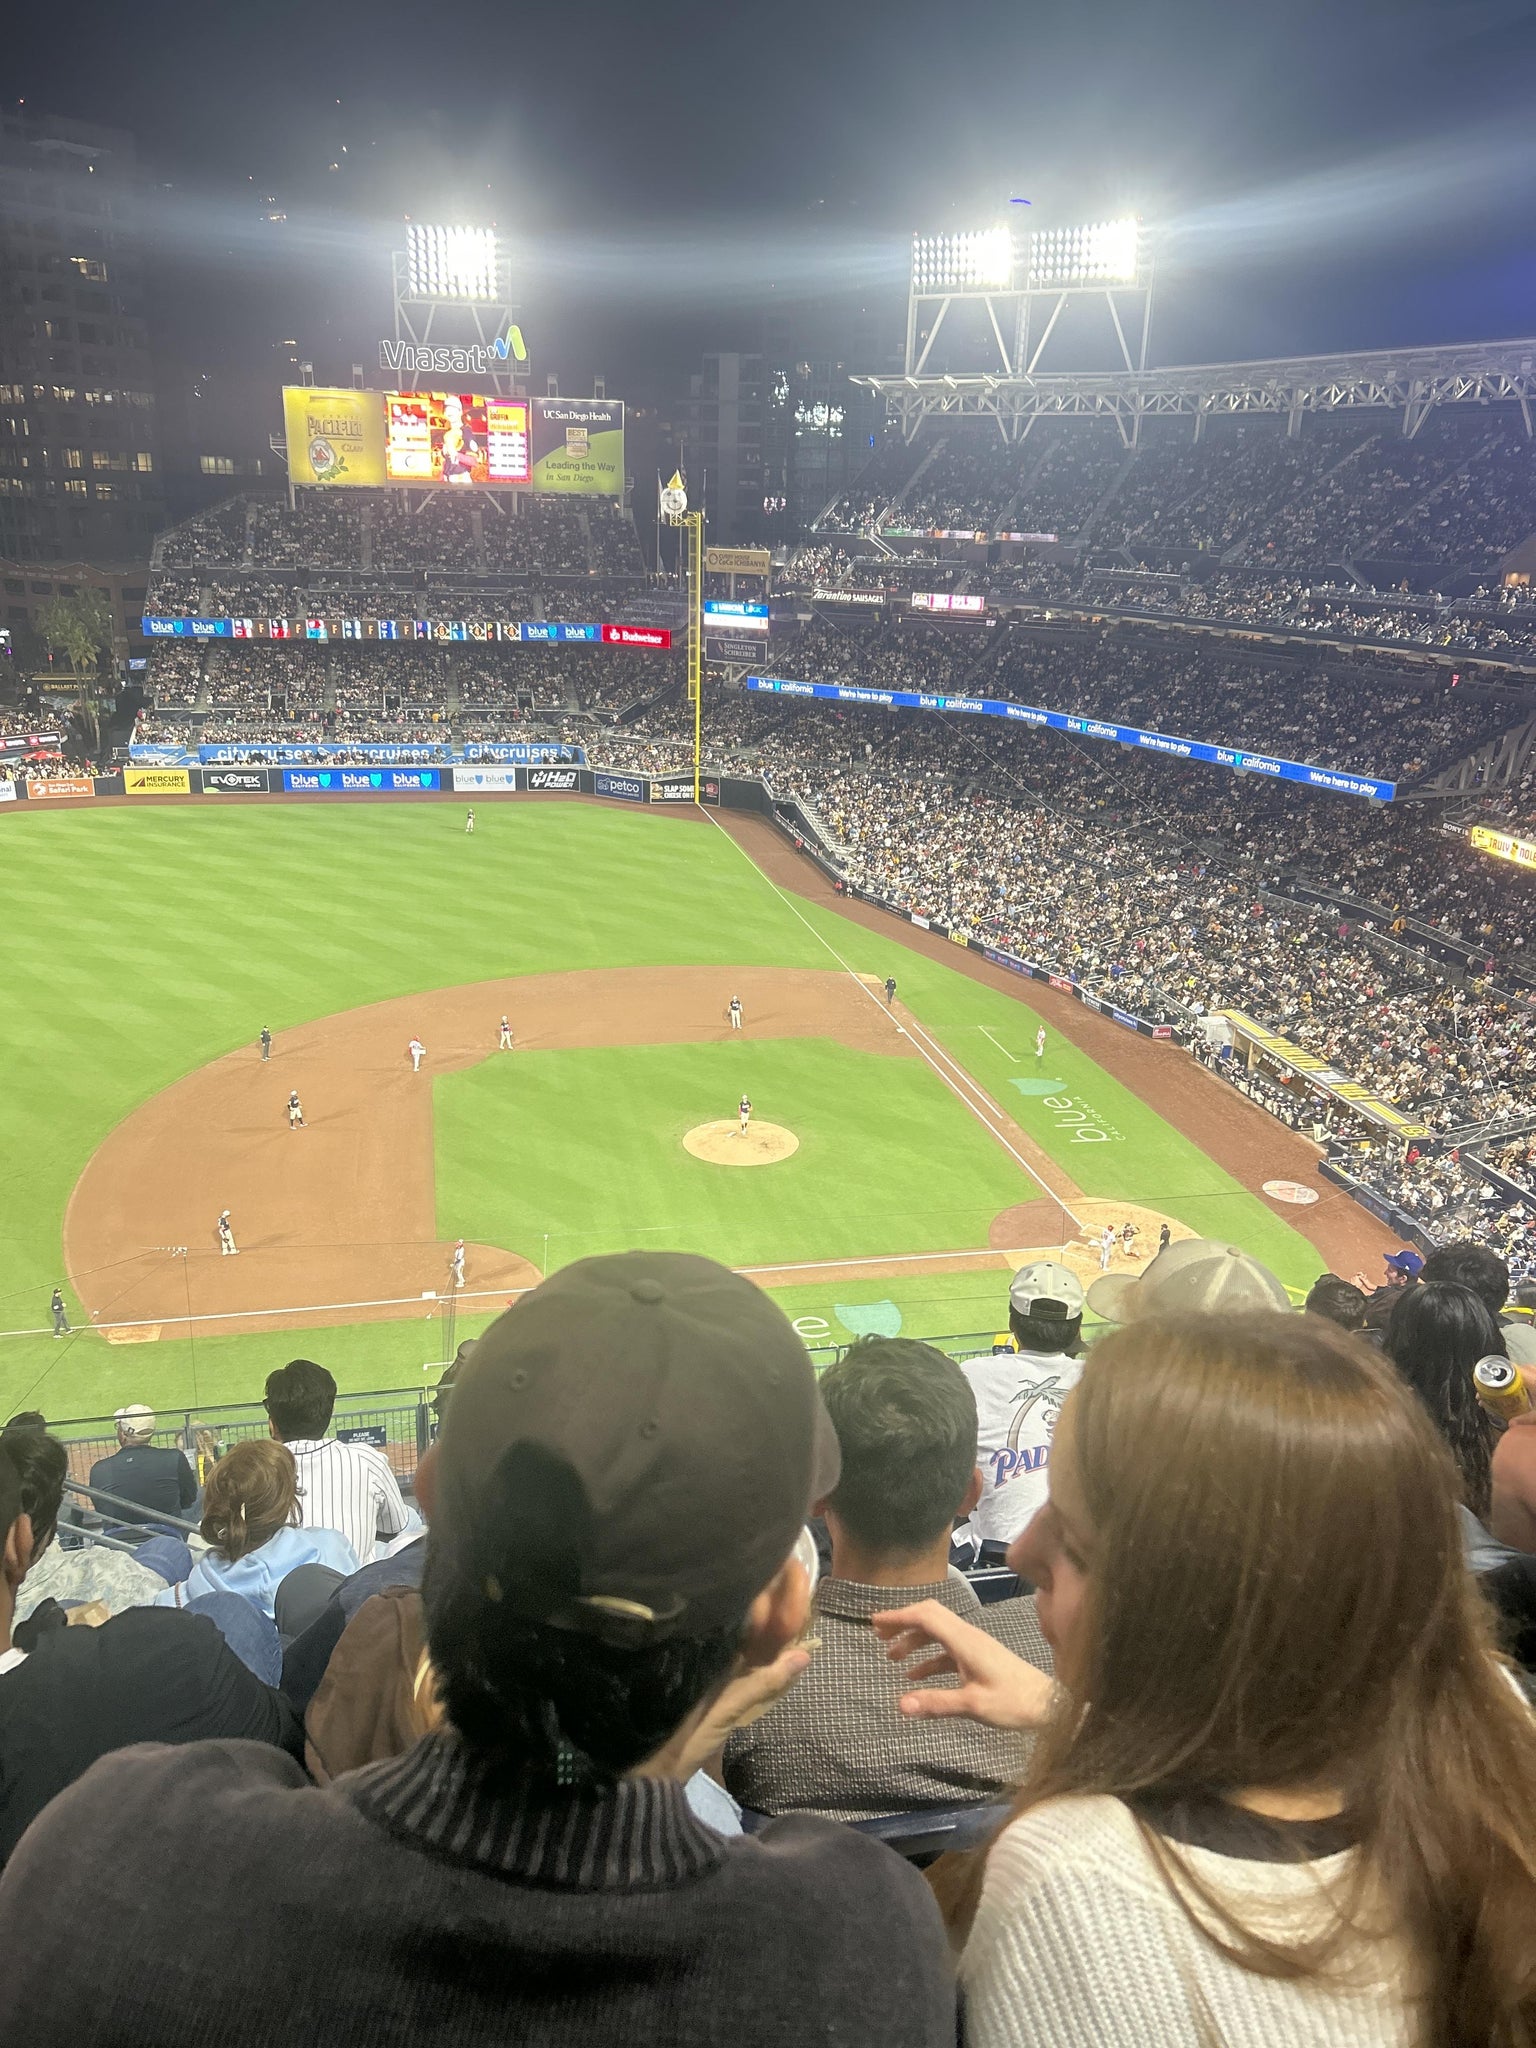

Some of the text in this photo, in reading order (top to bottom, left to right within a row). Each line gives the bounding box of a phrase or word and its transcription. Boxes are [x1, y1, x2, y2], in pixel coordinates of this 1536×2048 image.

[383, 340, 487, 374] Viasat
[543, 410, 611, 422] UC San Diego Health
[545, 461, 616, 473] Leading the Way
[546, 473, 594, 484] in San Diego
[852, 593, 884, 604] SAUSAGES
[151, 620, 174, 631] blue
[192, 621, 215, 632] blue
[527, 626, 549, 636] blue
[565, 627, 586, 637] blue
[622, 631, 663, 644] Budweiser
[724, 642, 757, 651] SINGLETON
[758, 680, 814, 694] blue california
[879, 695, 894, 704] play
[920, 696, 983, 711] blue california
[1067, 719, 1117, 738] blue california
[1156, 739, 1170, 750] here
[1177, 744, 1192, 756] play
[1216, 750, 1281, 774] blue california
[290, 773, 319, 786] blue
[342, 773, 370, 786] blue
[392, 773, 420, 786] blue
[455, 775, 475, 784] blue
[485, 775, 505, 784] blue
[1310, 771, 1378, 797] We're here to play
[610, 780, 640, 793] petco
[663, 785, 679, 793] SLAP
[1042, 1096, 1112, 1143] blue
[1073, 1096, 1126, 1141] CALIFORNIA
